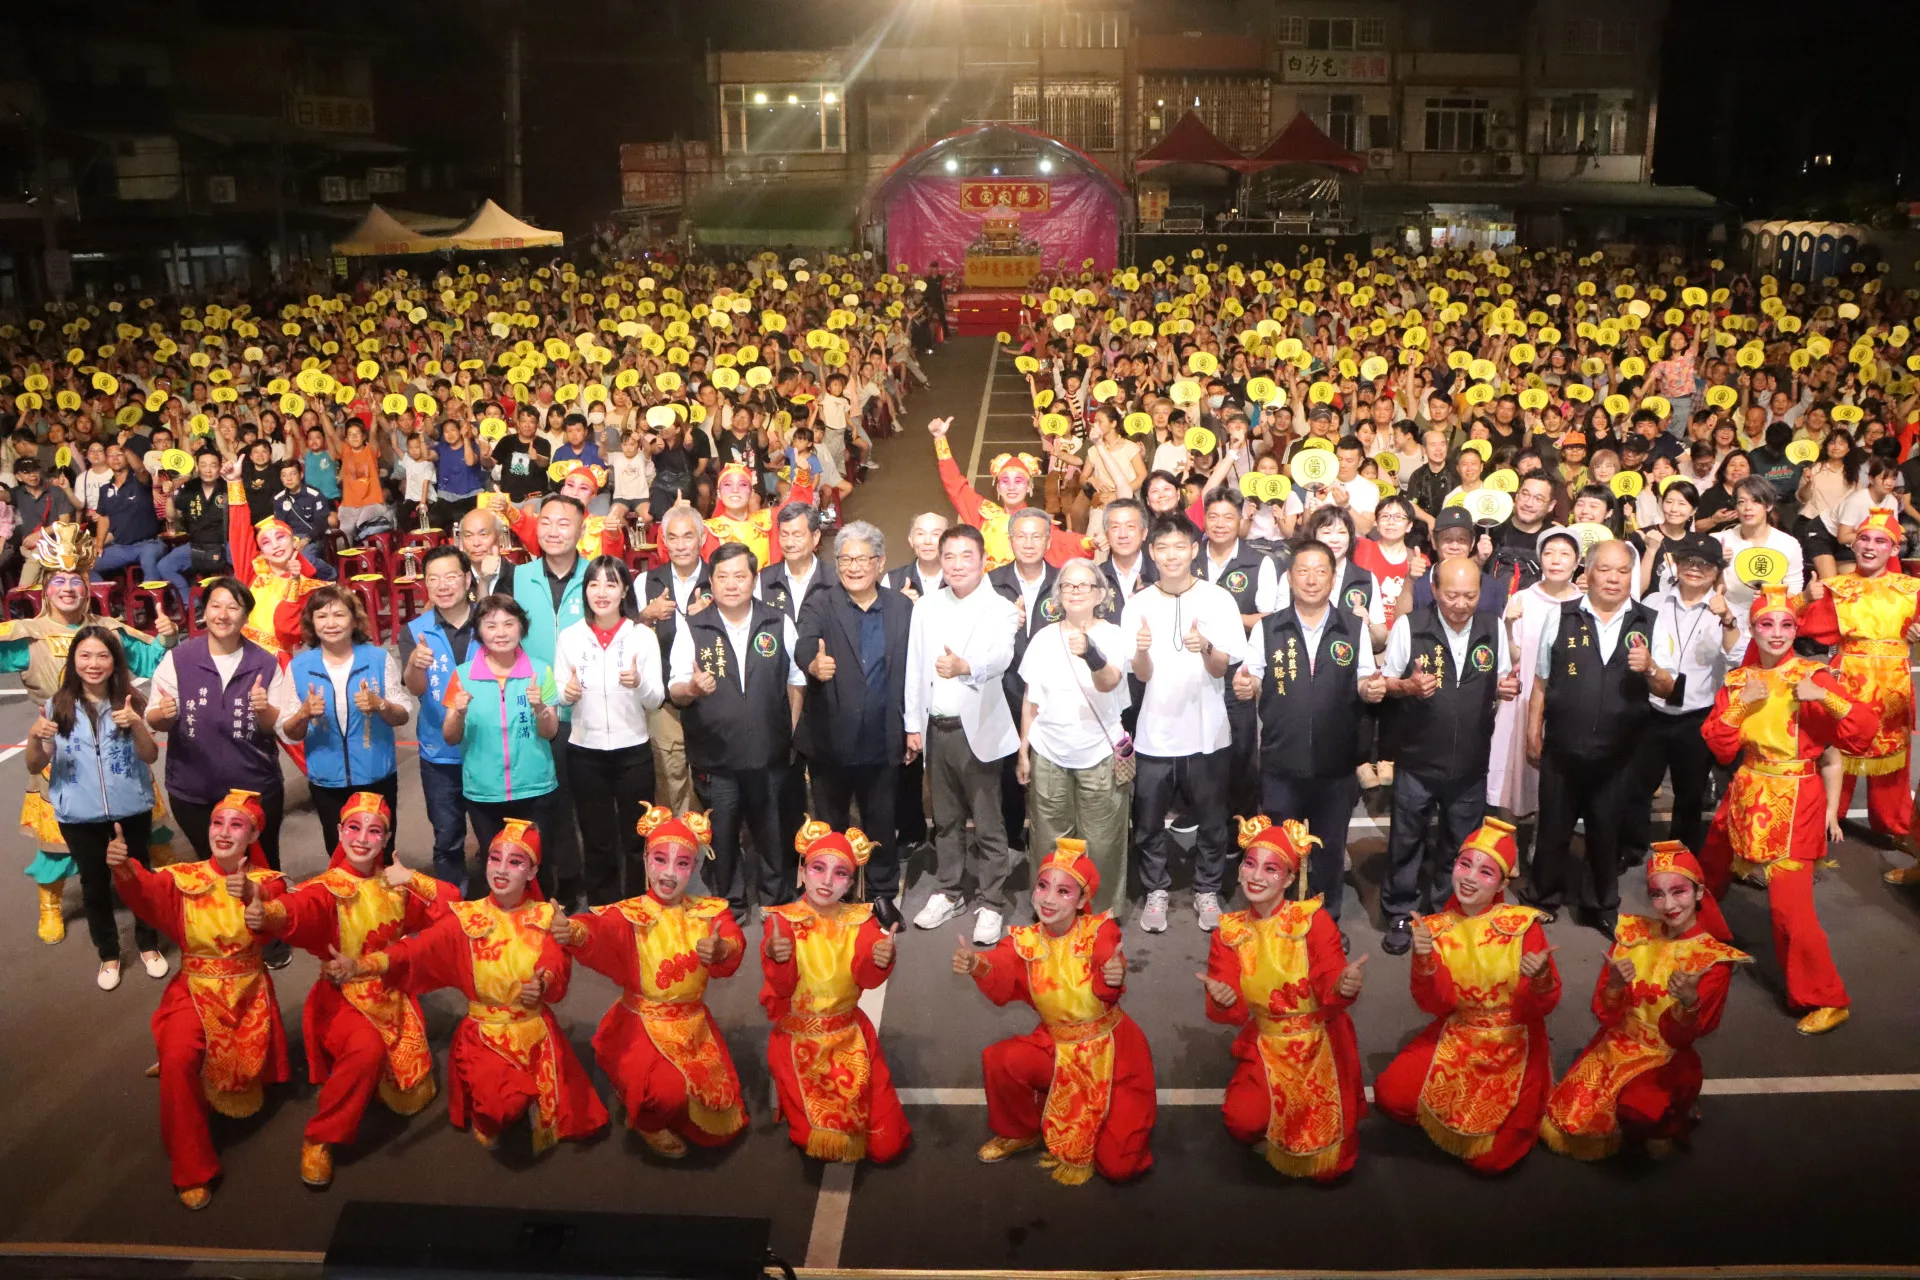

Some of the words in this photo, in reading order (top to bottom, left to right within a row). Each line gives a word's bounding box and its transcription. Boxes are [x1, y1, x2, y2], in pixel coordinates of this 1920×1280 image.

[714, 636, 727, 678] 主任委員
[1434, 644, 1446, 689] 常務委員
